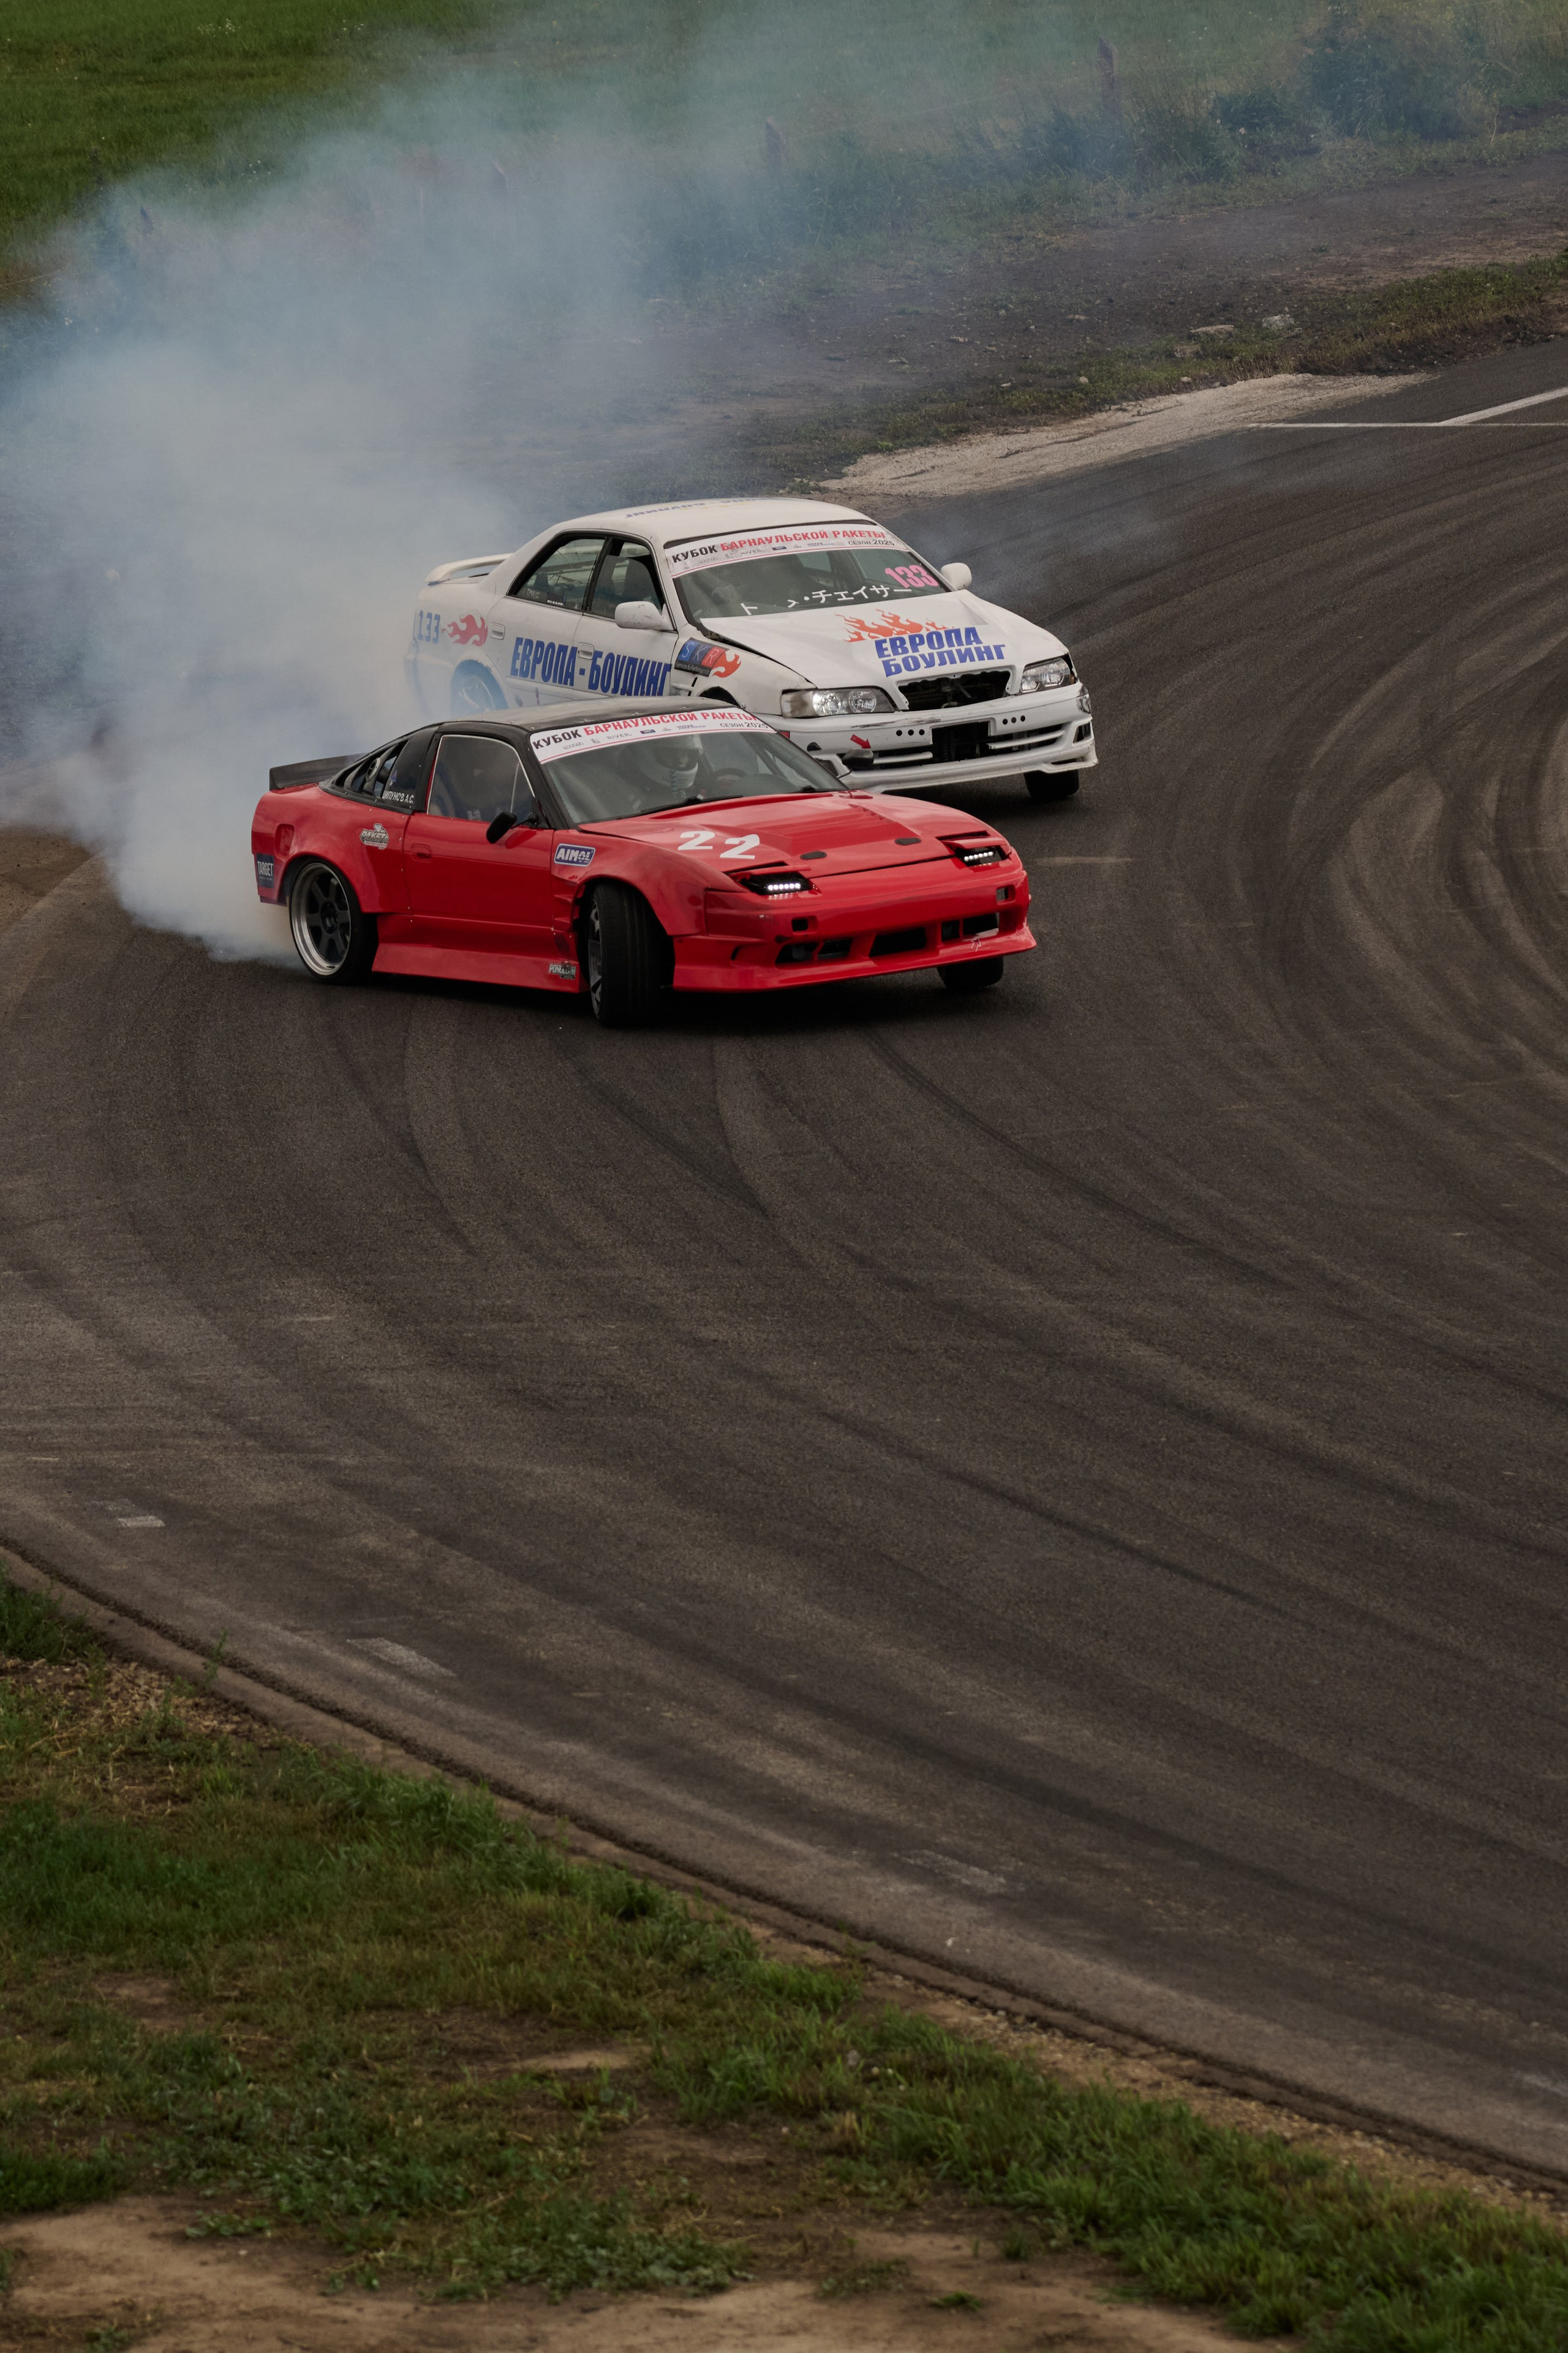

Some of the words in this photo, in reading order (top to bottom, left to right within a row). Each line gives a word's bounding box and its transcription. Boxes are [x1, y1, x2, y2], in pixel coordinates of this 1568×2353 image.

[672, 544, 718, 563] КУБОК
[720, 530, 829, 551] БАРНАУЛЬСКОЙ
[884, 565, 939, 589] 133
[418, 610, 440, 644] 133
[875, 627, 983, 658] ЕВРОПА
[510, 637, 578, 687] ЕВРОПА
[588, 650, 673, 696] БОУЛИНГ
[682, 642, 719, 664] SKR
[882, 644, 1006, 677] БОУЛИНГ
[532, 729, 582, 749] КУБОК
[584, 712, 698, 736] БАРНАУЛЬСКОЙ
[701, 712, 759, 721] РАКЕТЫ
[257, 861, 273, 876] TARGET
[556, 848, 590, 862] AIMOL
